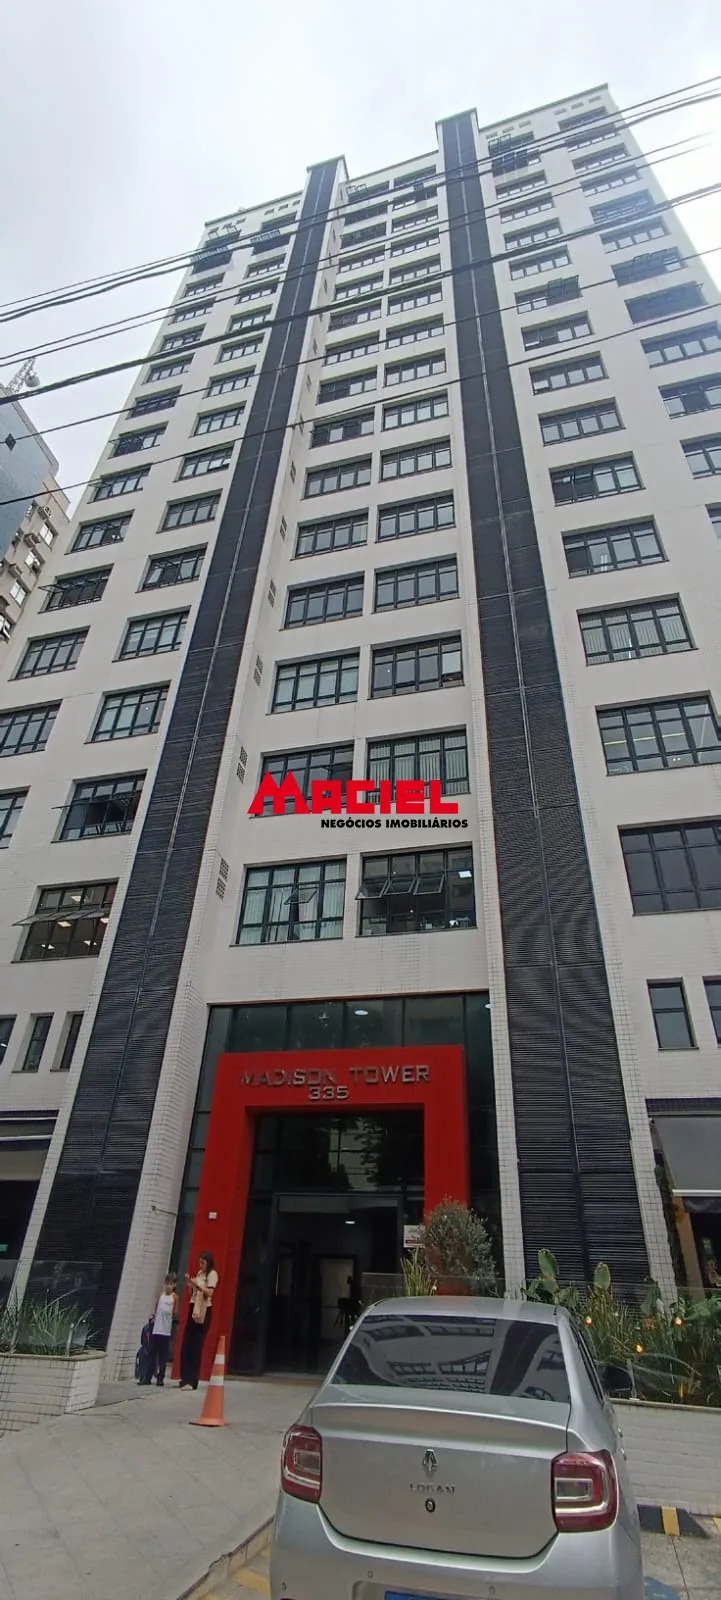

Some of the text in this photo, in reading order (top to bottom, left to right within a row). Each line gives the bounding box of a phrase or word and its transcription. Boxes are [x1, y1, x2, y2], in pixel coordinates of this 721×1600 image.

[240, 1065, 430, 1086] MADISON TOWER
[308, 1086, 349, 1100] 335
[409, 1482, 455, 1495] LOGAN
